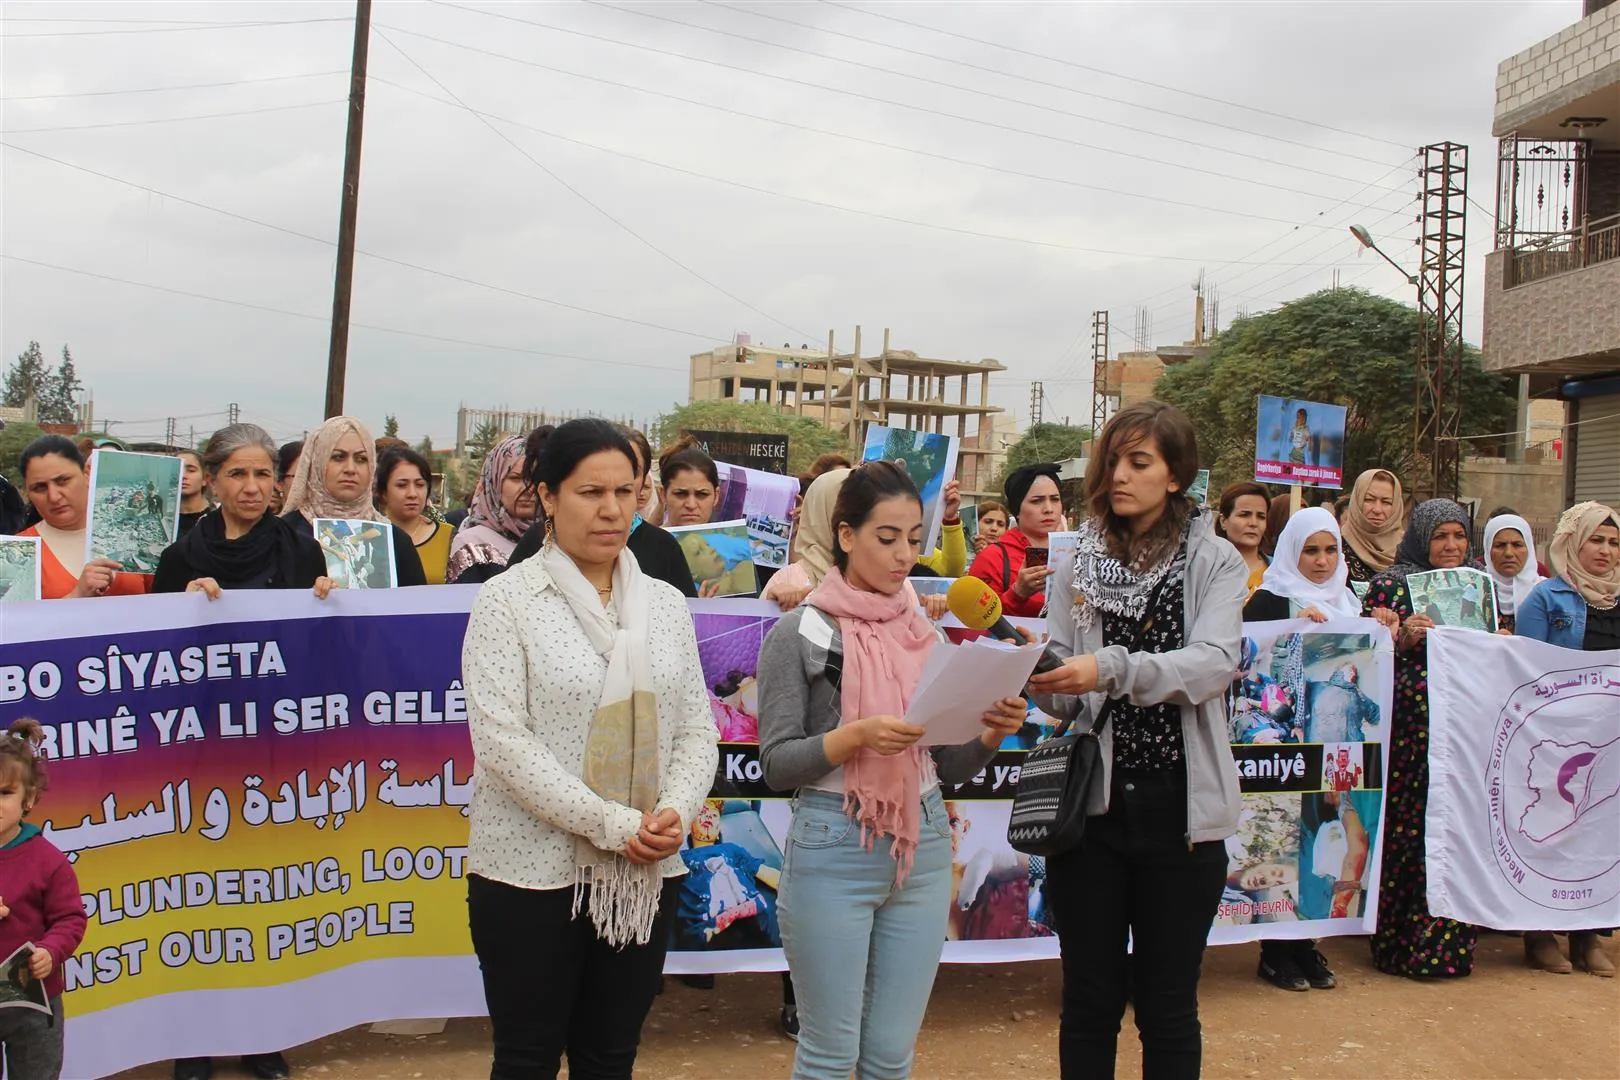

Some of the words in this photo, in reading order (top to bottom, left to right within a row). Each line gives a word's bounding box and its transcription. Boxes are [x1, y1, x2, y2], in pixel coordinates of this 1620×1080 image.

[750, 441, 785, 458] HESEKÊ
[0, 661, 62, 703] BO
[77, 641, 287, 696] SÎYASETA
[0, 706, 138, 762] RINÊ
[150, 707, 206, 746] YA
[219, 701, 258, 739] LI
[273, 693, 350, 736] SER
[363, 679, 468, 726] GELÊ
[198, 787, 231, 840] و
[241, 759, 367, 830] الإبادة
[1551, 888, 1593, 901] 8/9/2017
[159, 927, 255, 968] OUR
[267, 901, 415, 961] PEOPLE
